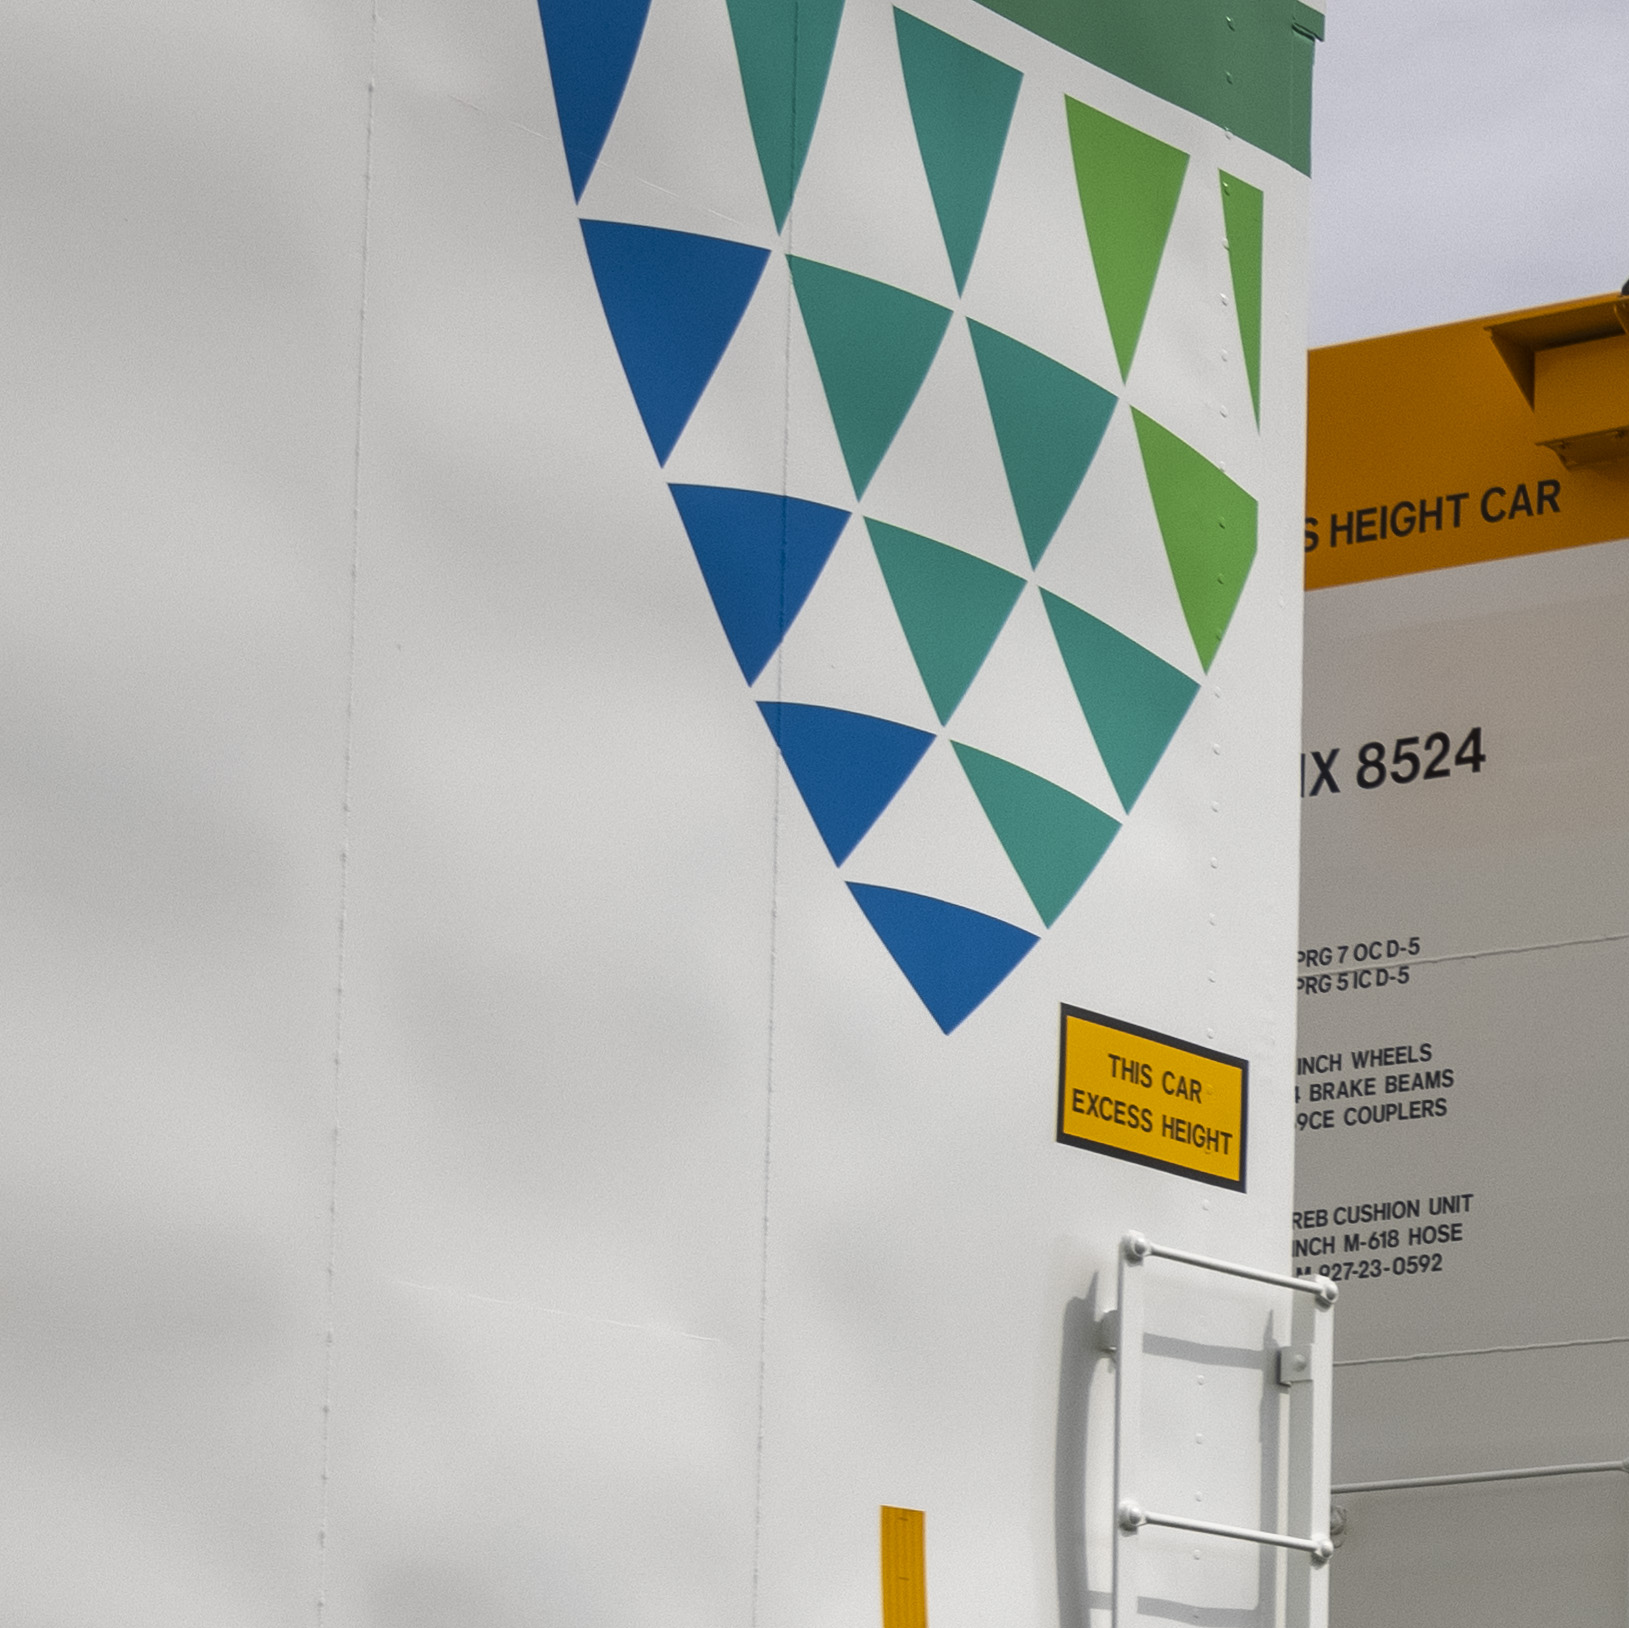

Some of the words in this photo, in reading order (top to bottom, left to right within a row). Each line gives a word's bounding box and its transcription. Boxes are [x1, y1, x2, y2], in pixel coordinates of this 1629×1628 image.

[1331, 493, 1469, 548] HEIGHT
[1480, 479, 1561, 523] CAR
[1356, 727, 1486, 789] 8524
[1337, 946, 1348, 963] 7
[1337, 973, 1348, 990] 5
[1297, 1054, 1342, 1075] INCH
[1351, 1043, 1432, 1069] WHEELS
[1108, 1053, 1152, 1088] THIS
[1162, 1071, 1203, 1104] CAR
[1310, 1078, 1376, 1101] BRAKE
[1385, 1069, 1454, 1093] BEAMS
[1072, 1088, 1153, 1133] EXCESS
[1162, 1115, 1233, 1155] HEIGHT
[1344, 1098, 1447, 1126] COUPLERS
[1333, 1200, 1420, 1225] CUSHION
[1429, 1194, 1474, 1215] UNIT
[1292, 1236, 1335, 1257] INCH
[1344, 1229, 1399, 1252] M-618
[1409, 1223, 1463, 1246] HOSE
